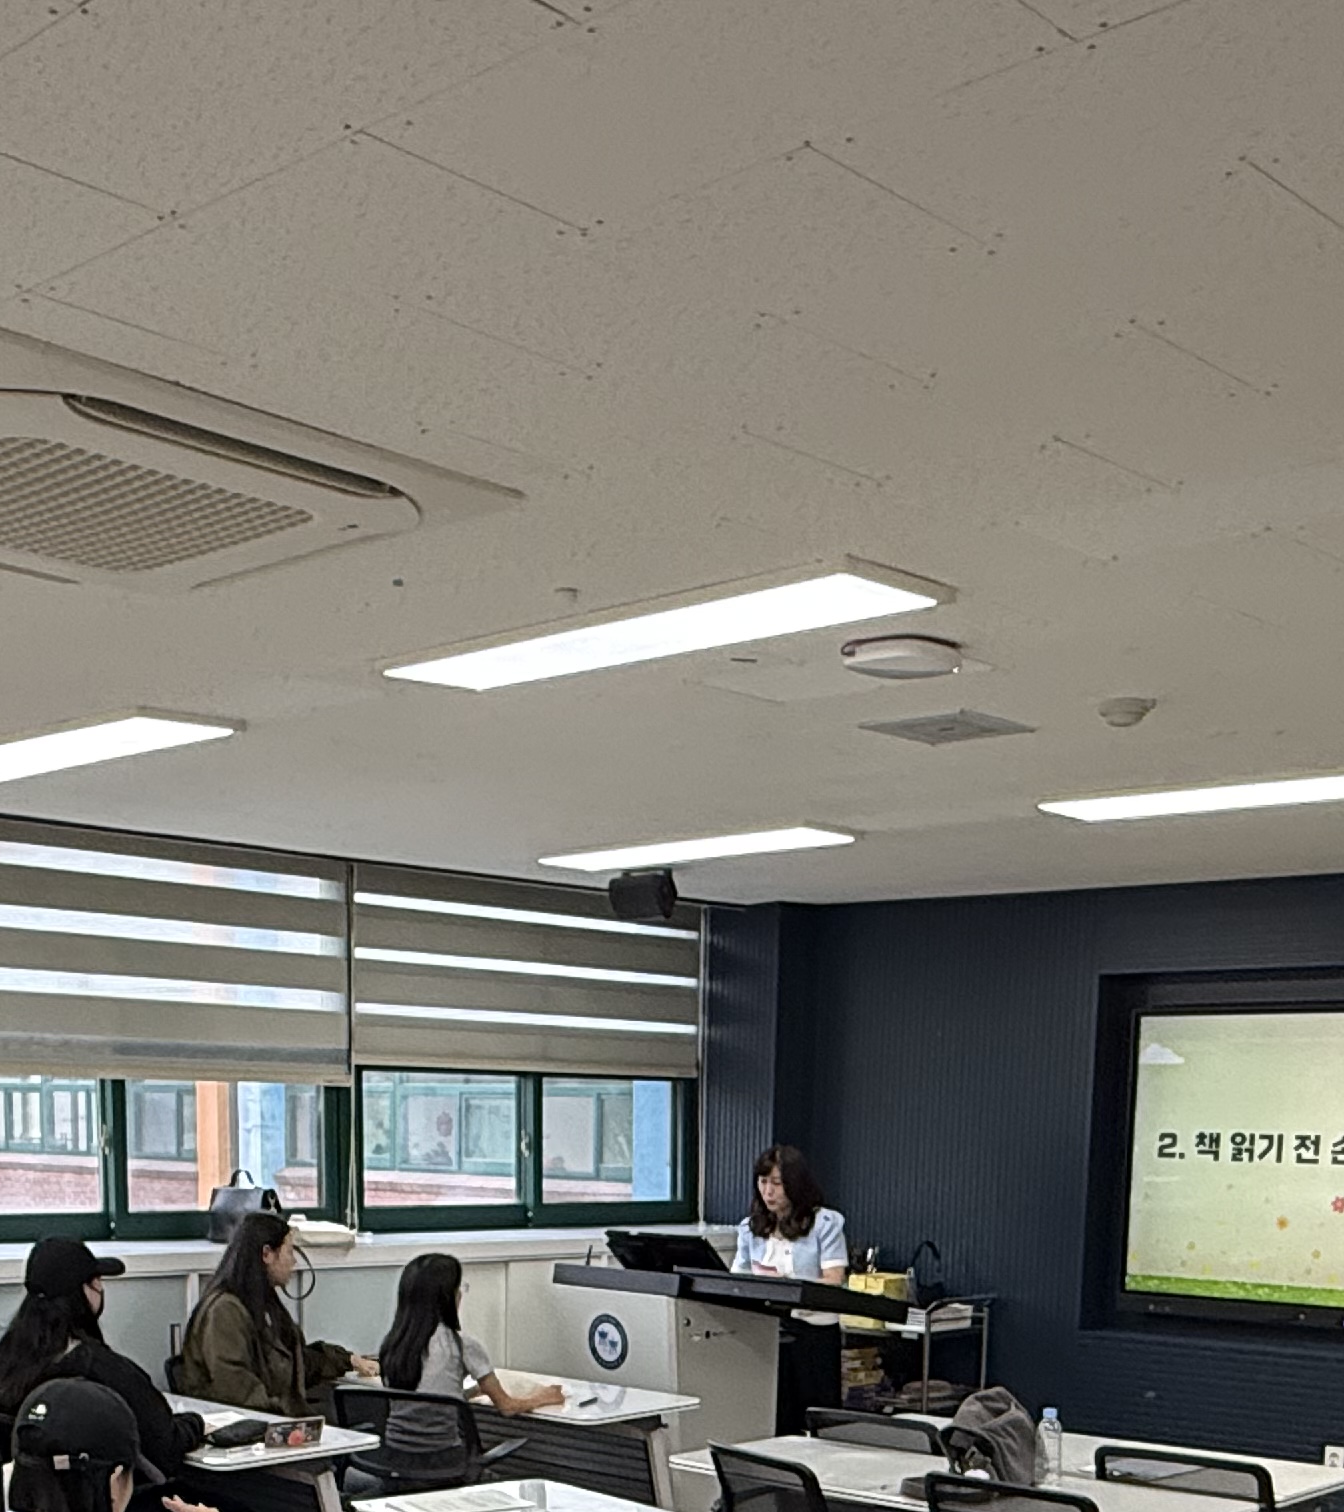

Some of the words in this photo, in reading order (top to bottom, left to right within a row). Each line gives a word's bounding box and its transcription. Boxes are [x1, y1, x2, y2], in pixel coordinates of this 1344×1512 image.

[1157, 1132, 1186, 1160] 2.
[1195, 1131, 1221, 1162] 책
[1229, 1131, 1284, 1163] 읽기
[1292, 1133, 1321, 1164] 전
